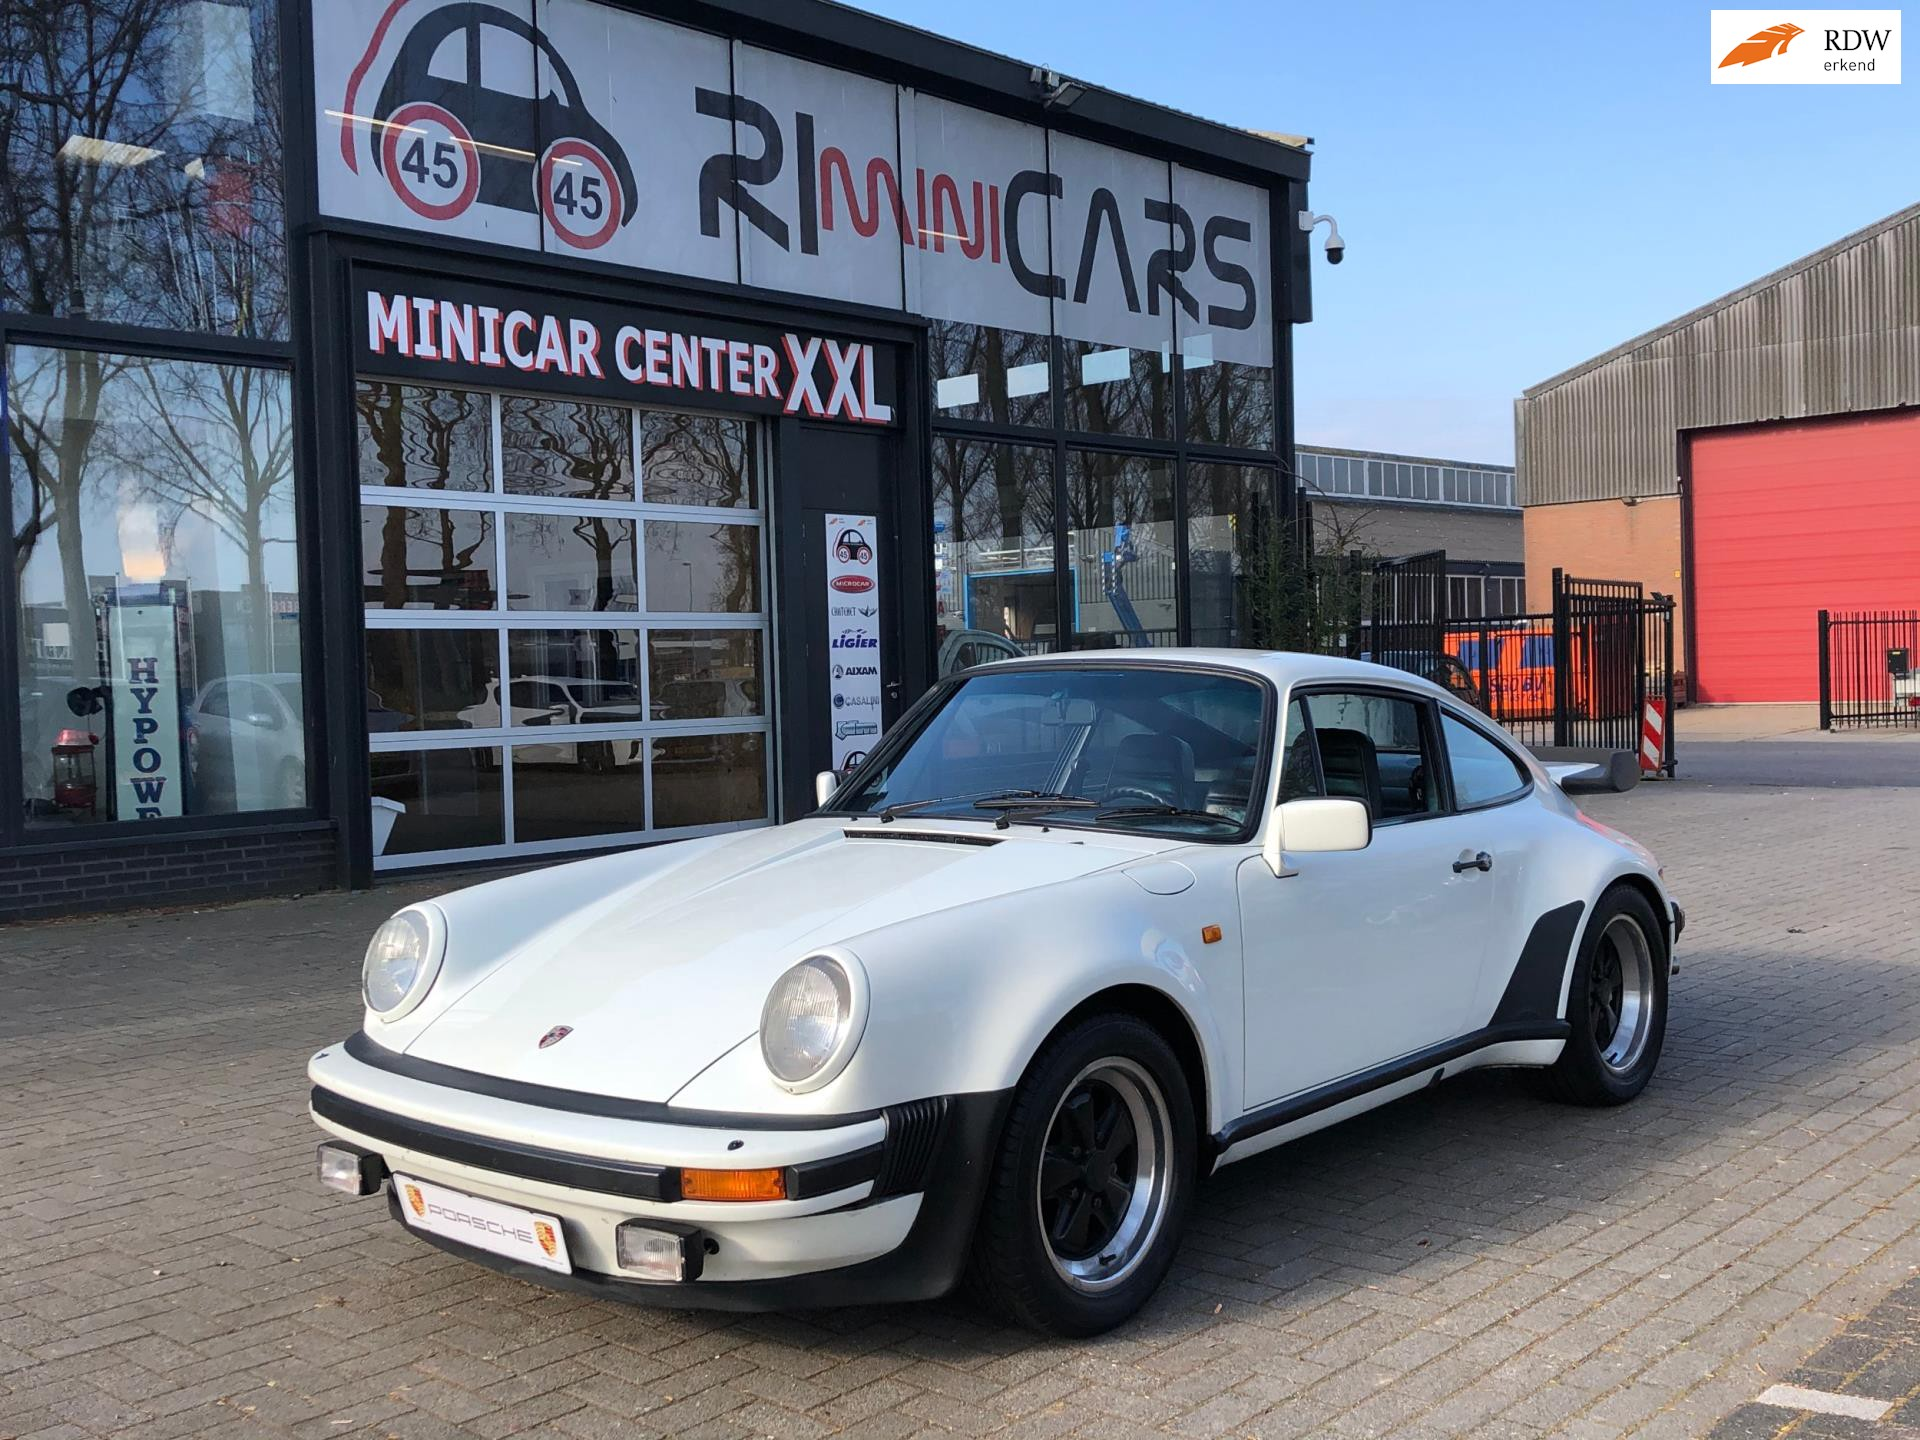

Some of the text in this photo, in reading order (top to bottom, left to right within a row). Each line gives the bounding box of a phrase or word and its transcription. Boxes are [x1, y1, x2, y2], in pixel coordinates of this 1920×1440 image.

[400, 136, 459, 190] 45
[552, 171, 602, 220] 45
[367, 290, 893, 425] MINICAR CENTER XXL
[845, 666, 878, 676] AIXAM
[428, 1204, 534, 1244] PORSCHE
